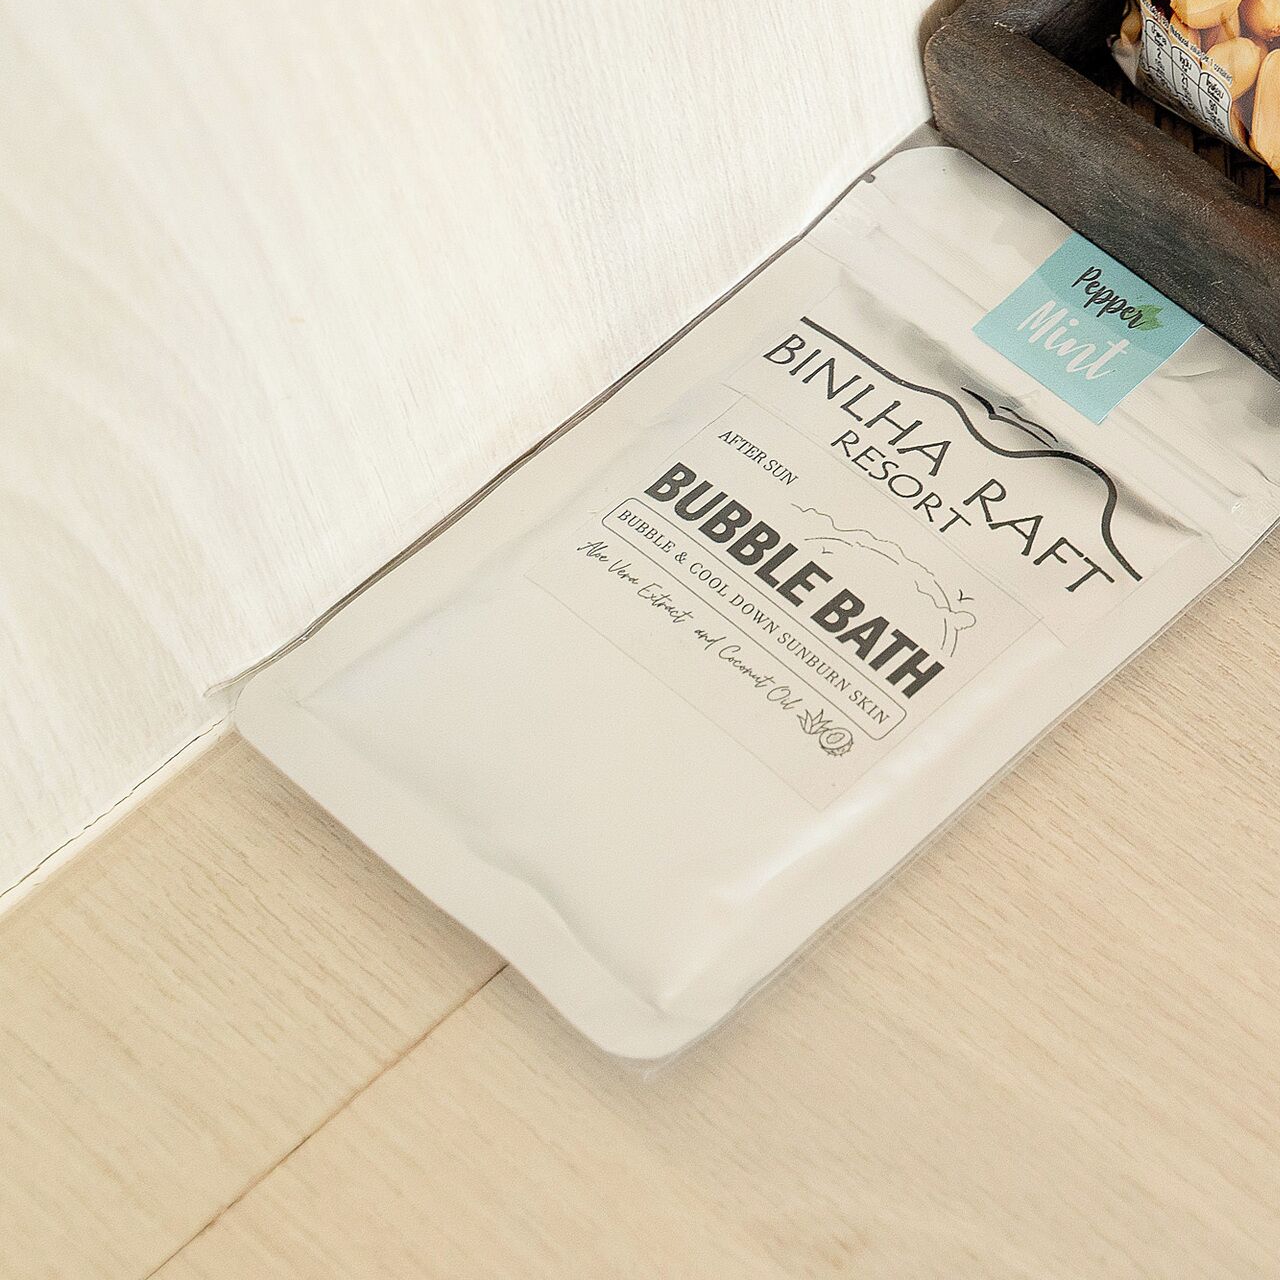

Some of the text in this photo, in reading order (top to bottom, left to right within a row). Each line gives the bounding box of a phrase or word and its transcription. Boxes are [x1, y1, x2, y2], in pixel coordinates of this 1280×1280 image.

[1016, 299, 1131, 381] Mint
[1071, 265, 1146, 330] Pepper
[718, 430, 799, 486] AFTER SUN
[762, 333, 1116, 593] BINLHA RAFT
[831, 429, 972, 533] RESORT
[576, 540, 803, 712] Aloe Vera Extract and Coconut Oil
[617, 508, 891, 726] BUBBLE & COOL DOWN SUNBURN SKIN
[643, 461, 945, 699] BUBBLE BATH
